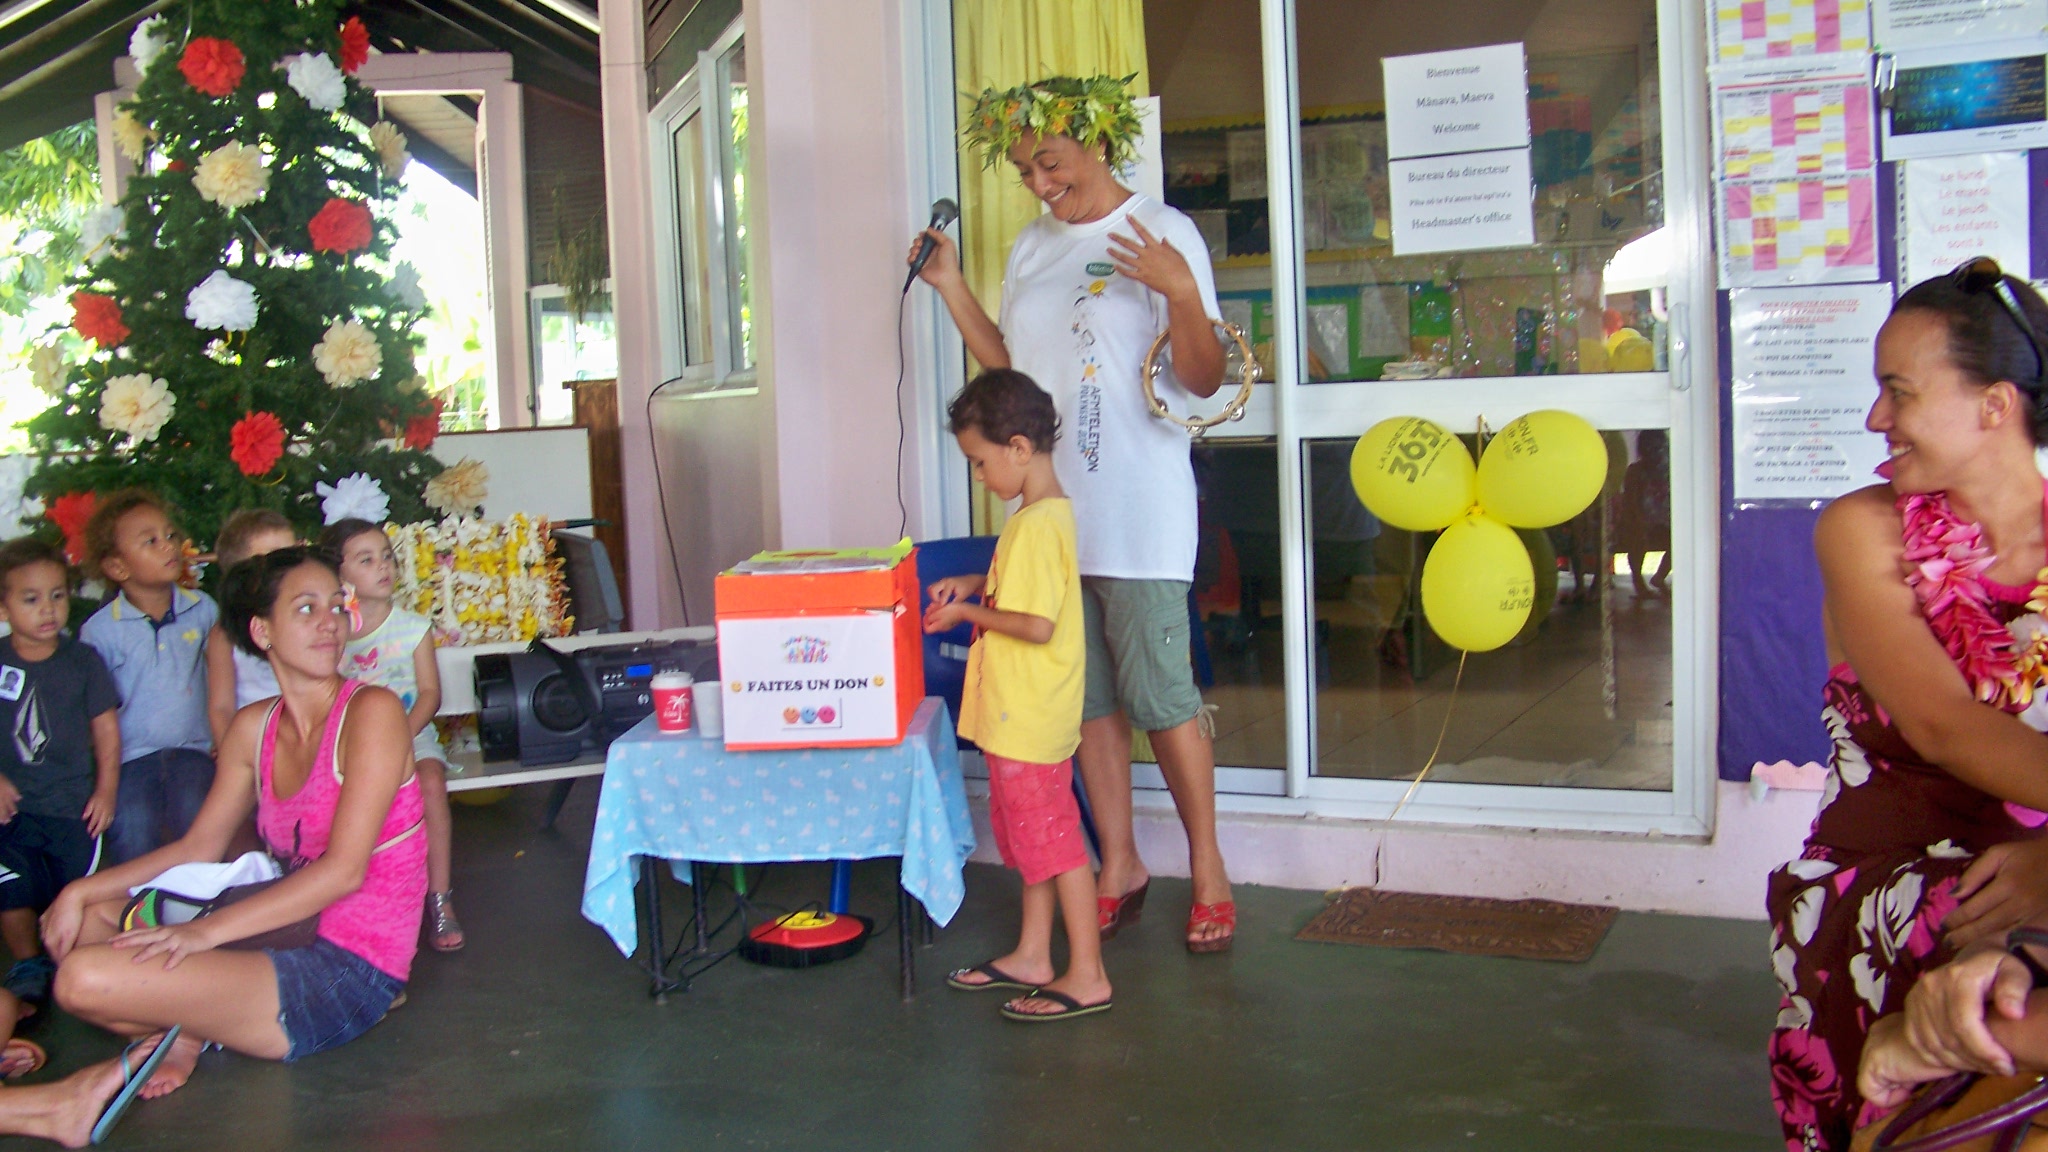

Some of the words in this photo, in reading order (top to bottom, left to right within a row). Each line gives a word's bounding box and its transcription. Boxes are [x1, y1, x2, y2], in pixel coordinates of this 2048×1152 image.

[1426, 65, 1480, 79] Bienvenue
[1461, 92, 1495, 103] Maeva
[1432, 122, 1480, 134] Welcome
[1408, 172, 1444, 182] Bureau
[1446, 168, 1460, 178] du
[1462, 165, 1511, 177] directeur
[1940, 173, 1954, 182] Le
[1939, 189, 1952, 200] Le
[1955, 186, 1991, 197] mardi
[1942, 206, 1956, 216] Le
[1412, 214, 1481, 229] Headmaster's
[1483, 211, 1512, 223] office
[1932, 224, 1951, 233] Les
[1954, 220, 1999, 232] enfants
[1947, 239, 1974, 249] sont
[748, 681, 803, 692] FAITES
[807, 679, 830, 690] UN
[834, 678, 869, 690] DON
